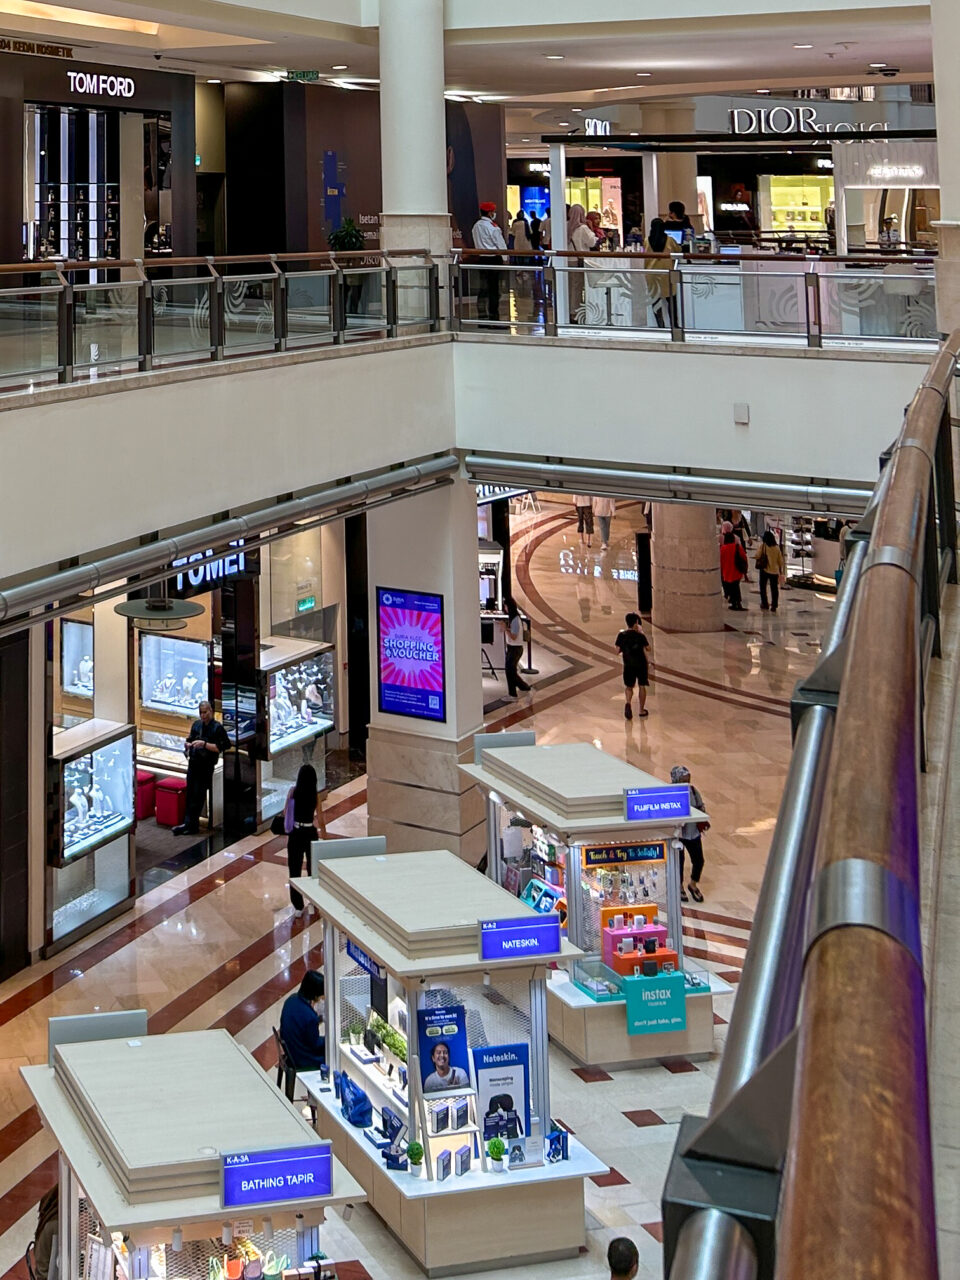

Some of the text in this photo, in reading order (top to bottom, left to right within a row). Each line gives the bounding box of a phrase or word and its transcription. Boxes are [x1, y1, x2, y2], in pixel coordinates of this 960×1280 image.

[36, 43, 74, 59] KOSMETIK
[67, 71, 135, 98] TOM FORD
[728, 106, 818, 134] DIOR
[359, 213, 378, 224] Isetan
[384, 638, 434, 652] SHOPPING
[634, 801, 681, 812] FUJIFILM INSTAX
[589, 849, 607, 860] Touch
[616, 849, 628, 861] Try
[502, 938, 539, 949] NATESKIN.
[642, 988, 671, 1001] instax
[483, 1052, 518, 1063] Nateskin.
[226, 1154, 250, 1164] K-A-3A
[241, 1173, 314, 1191] BATHING TAPIR
